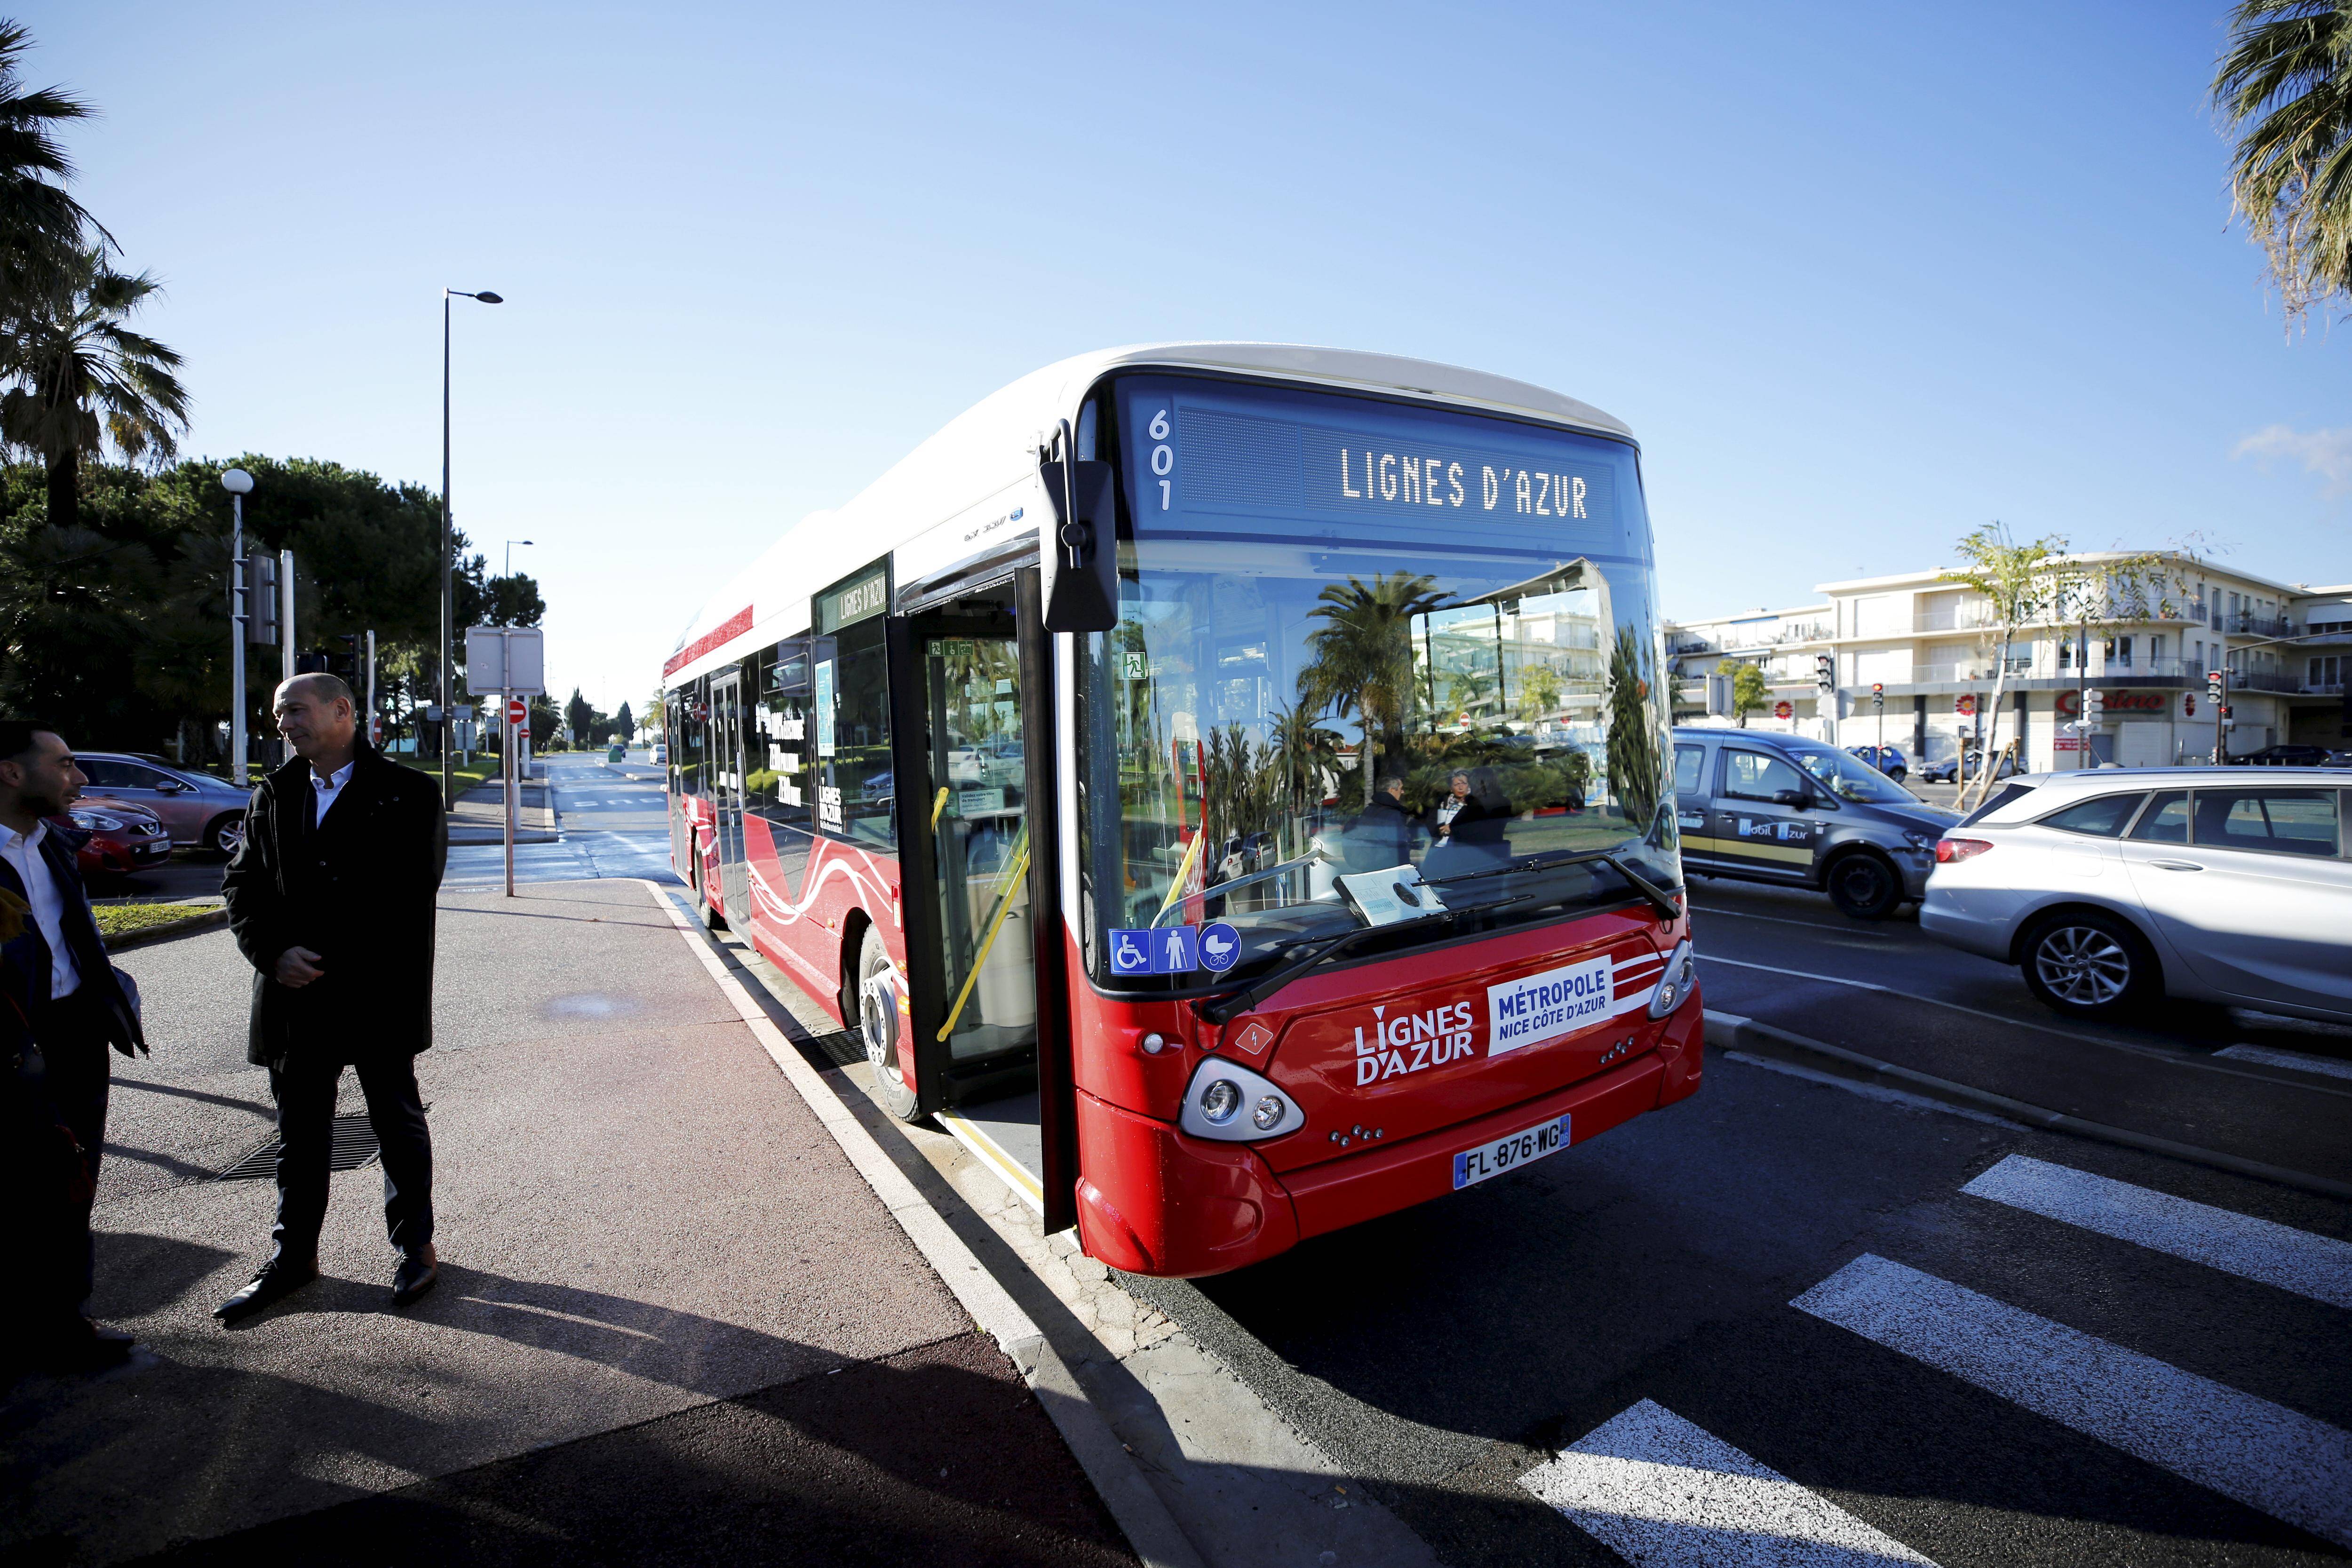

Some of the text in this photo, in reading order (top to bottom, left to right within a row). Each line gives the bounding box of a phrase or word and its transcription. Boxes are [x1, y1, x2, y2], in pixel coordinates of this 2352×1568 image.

[1149, 409, 1173, 511] 601
[1341, 448, 1587, 519] LIGNES D'AZUR
[841, 588, 862, 620] LIGNES
[2056, 689, 2166, 714] Csino
[818, 776, 842, 806] LIGNES
[1740, 819, 1772, 836] Mobil
[1499, 970, 1605, 1020] MÉTROPOLE
[1499, 995, 1605, 1041] NICE CÔTE D'AZUR
[1354, 1001, 1474, 1057] LIGNES
[1357, 1031, 1474, 1086] D'AZUR
[1467, 1124, 1559, 1180] FL-876-WG
[1560, 1132, 1569, 1145] 06
